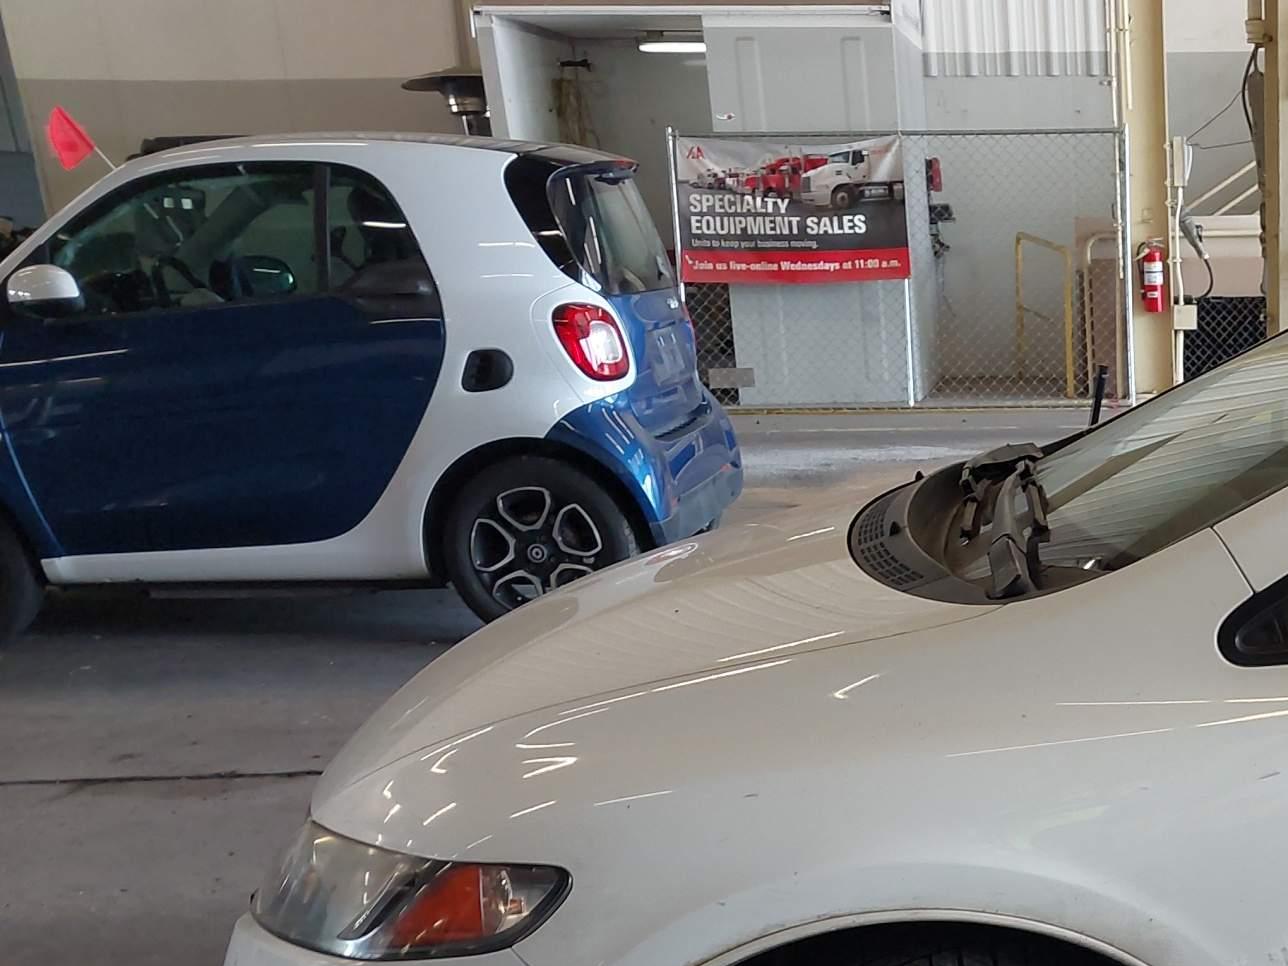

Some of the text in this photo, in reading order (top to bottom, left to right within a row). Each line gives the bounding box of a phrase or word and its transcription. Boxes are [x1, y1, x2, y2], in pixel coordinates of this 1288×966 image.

[689, 193, 790, 213] SPECIALTY
[690, 214, 867, 235] EQUIPMENT SALES
[693, 260, 714, 270] Join
[715, 262, 728, 270] us
[780, 260, 840, 272] Wednesdays
[842, 260, 852, 269] at
